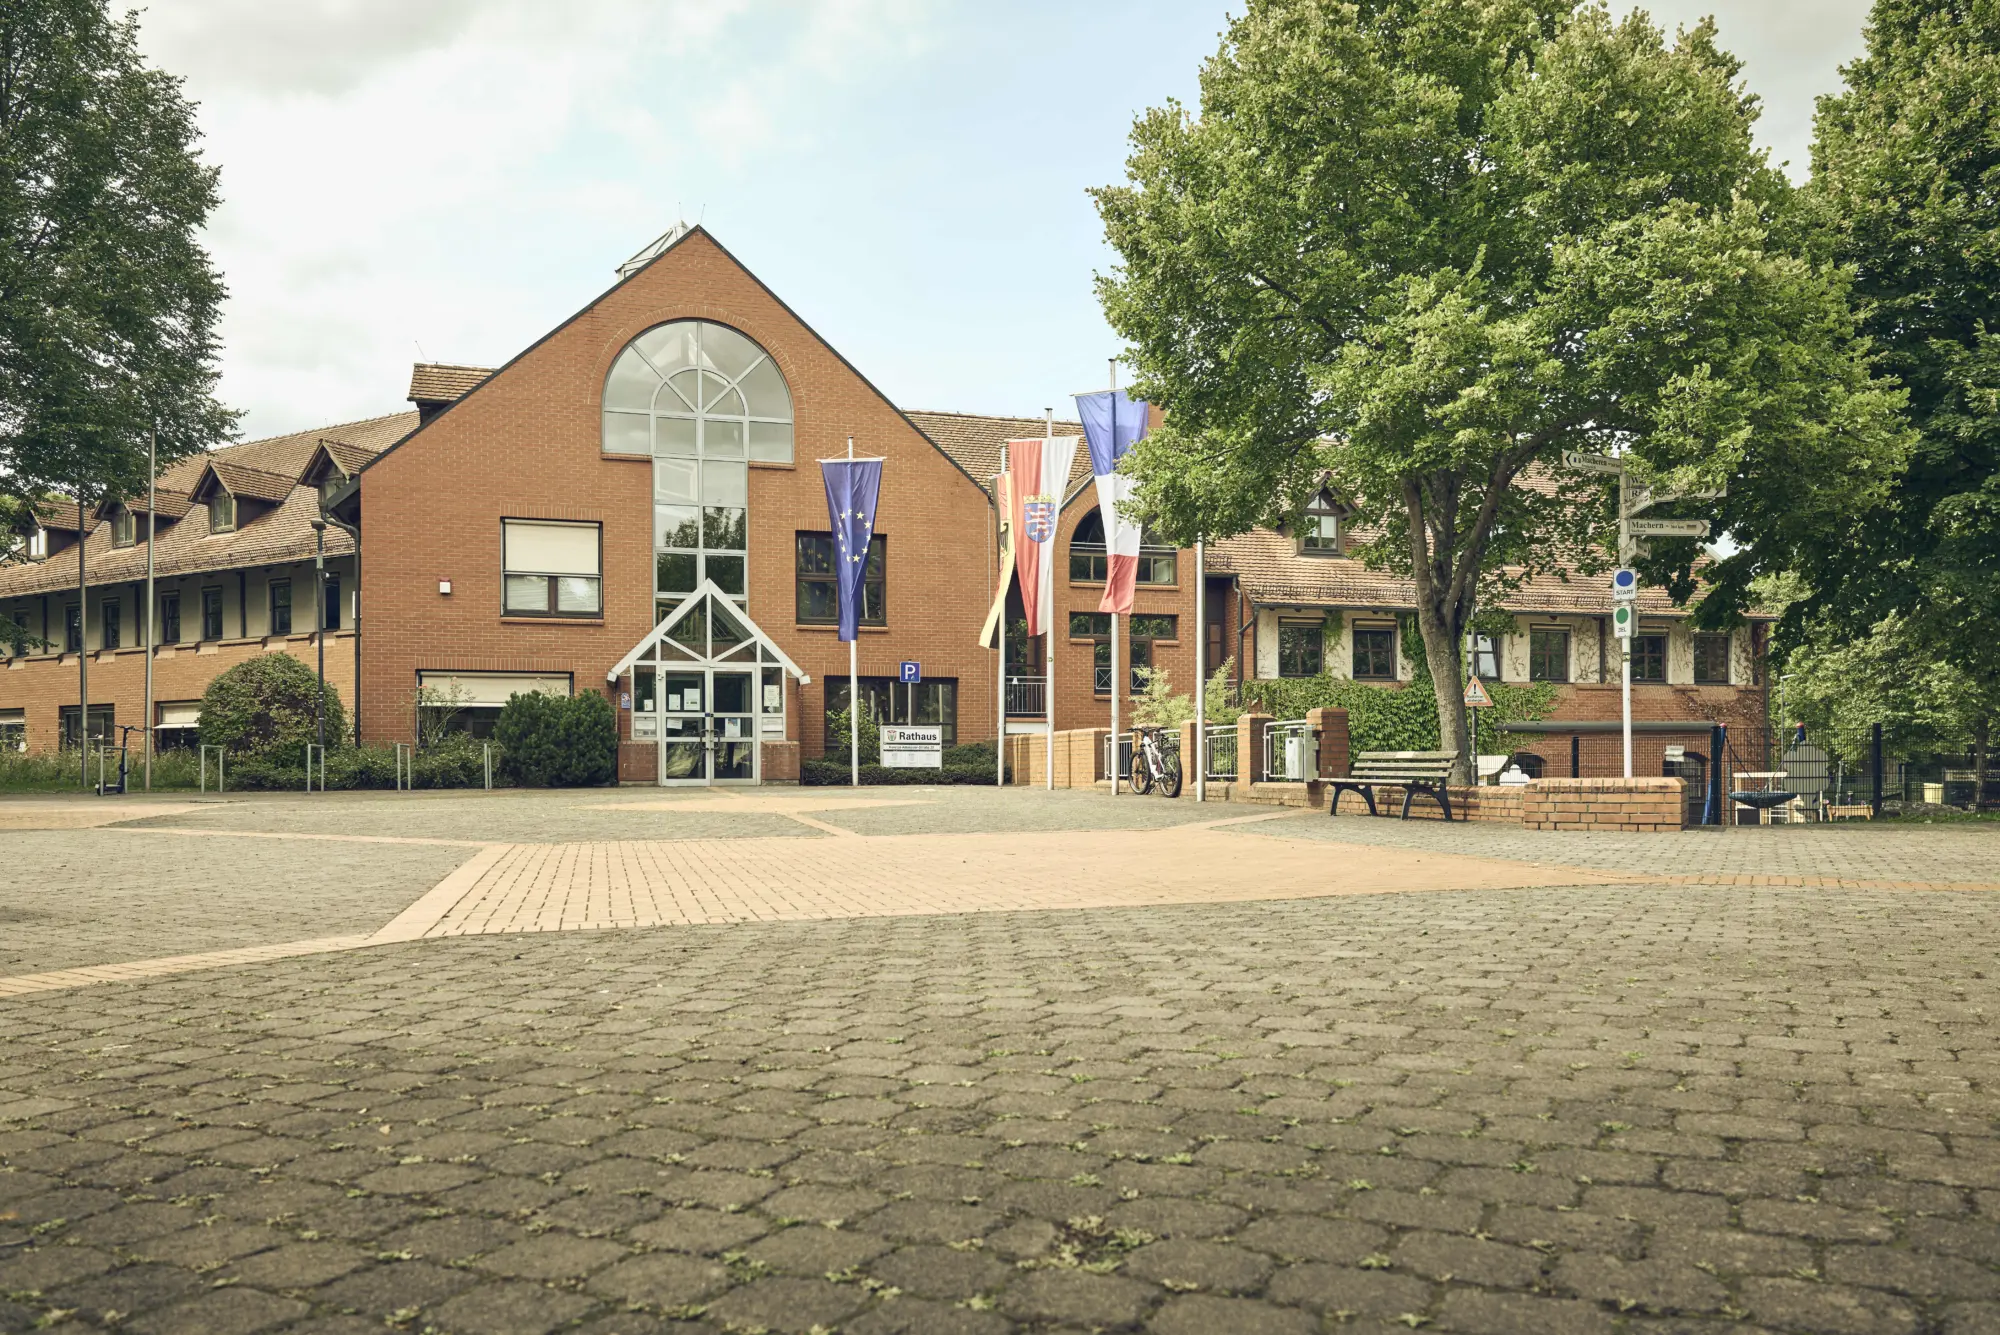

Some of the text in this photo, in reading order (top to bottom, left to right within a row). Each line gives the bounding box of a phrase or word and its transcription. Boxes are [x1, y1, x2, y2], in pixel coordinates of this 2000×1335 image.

[1631, 521, 1664, 529] Machern
[904, 664, 916, 680] P
[899, 731, 937, 741] Rathaus
